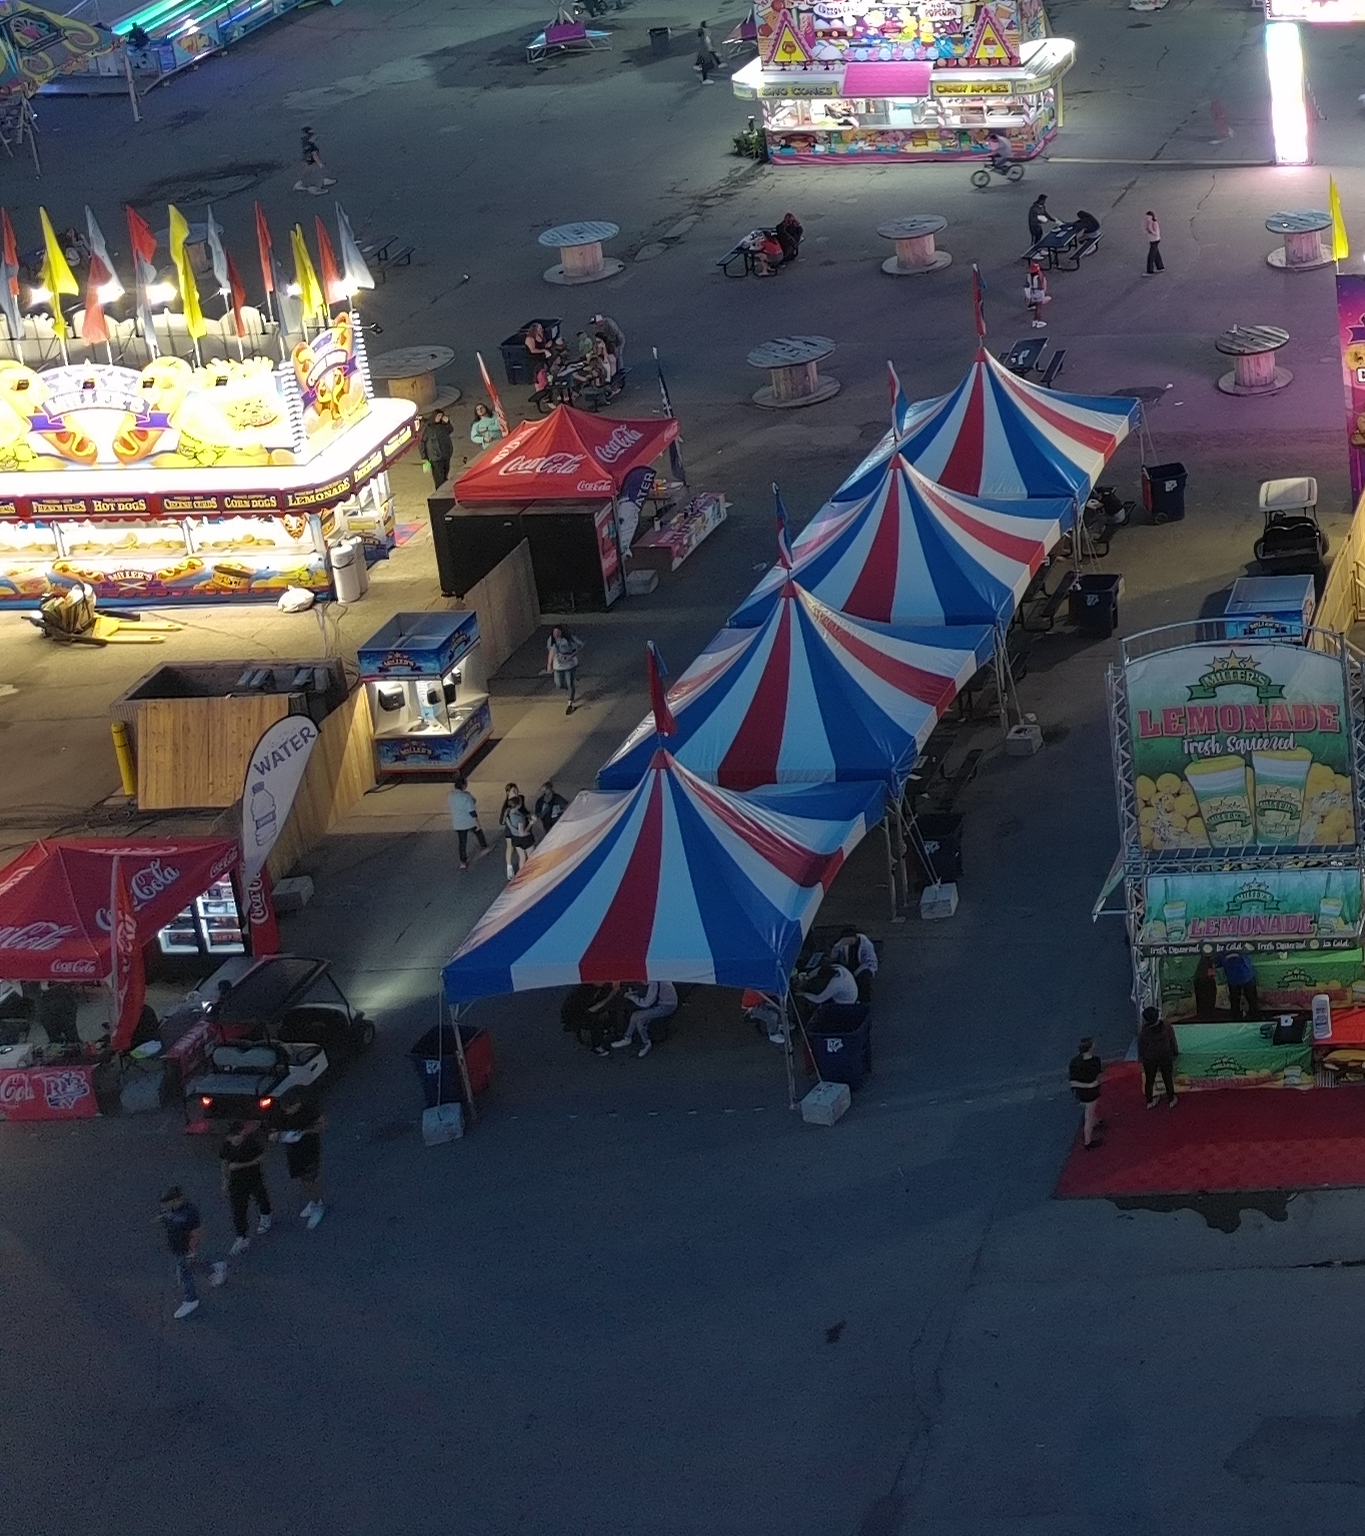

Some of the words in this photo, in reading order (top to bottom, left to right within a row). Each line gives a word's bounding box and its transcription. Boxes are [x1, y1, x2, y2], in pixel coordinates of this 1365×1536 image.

[792, 86, 833, 95] CONES
[936, 84, 968, 94] CANDY
[971, 83, 1009, 94] APPLES
[287, 478, 351, 506] LEMONADE
[634, 471, 656, 508] ATER
[93, 500, 117, 512] HOT
[118, 499, 146, 512] DOGS
[224, 497, 249, 509] CORN
[250, 497, 278, 509] DOGS
[108, 569, 153, 583] MILLER'S
[1204, 670, 1270, 687] MILLER'S
[1138, 703, 1340, 739] LEMONADE
[252, 725, 316, 777] WATER
[1182, 739, 1223, 755] Fresh
[1226, 734, 1297, 755] Squeezed
[1188, 913, 1315, 937] LEMONADE
